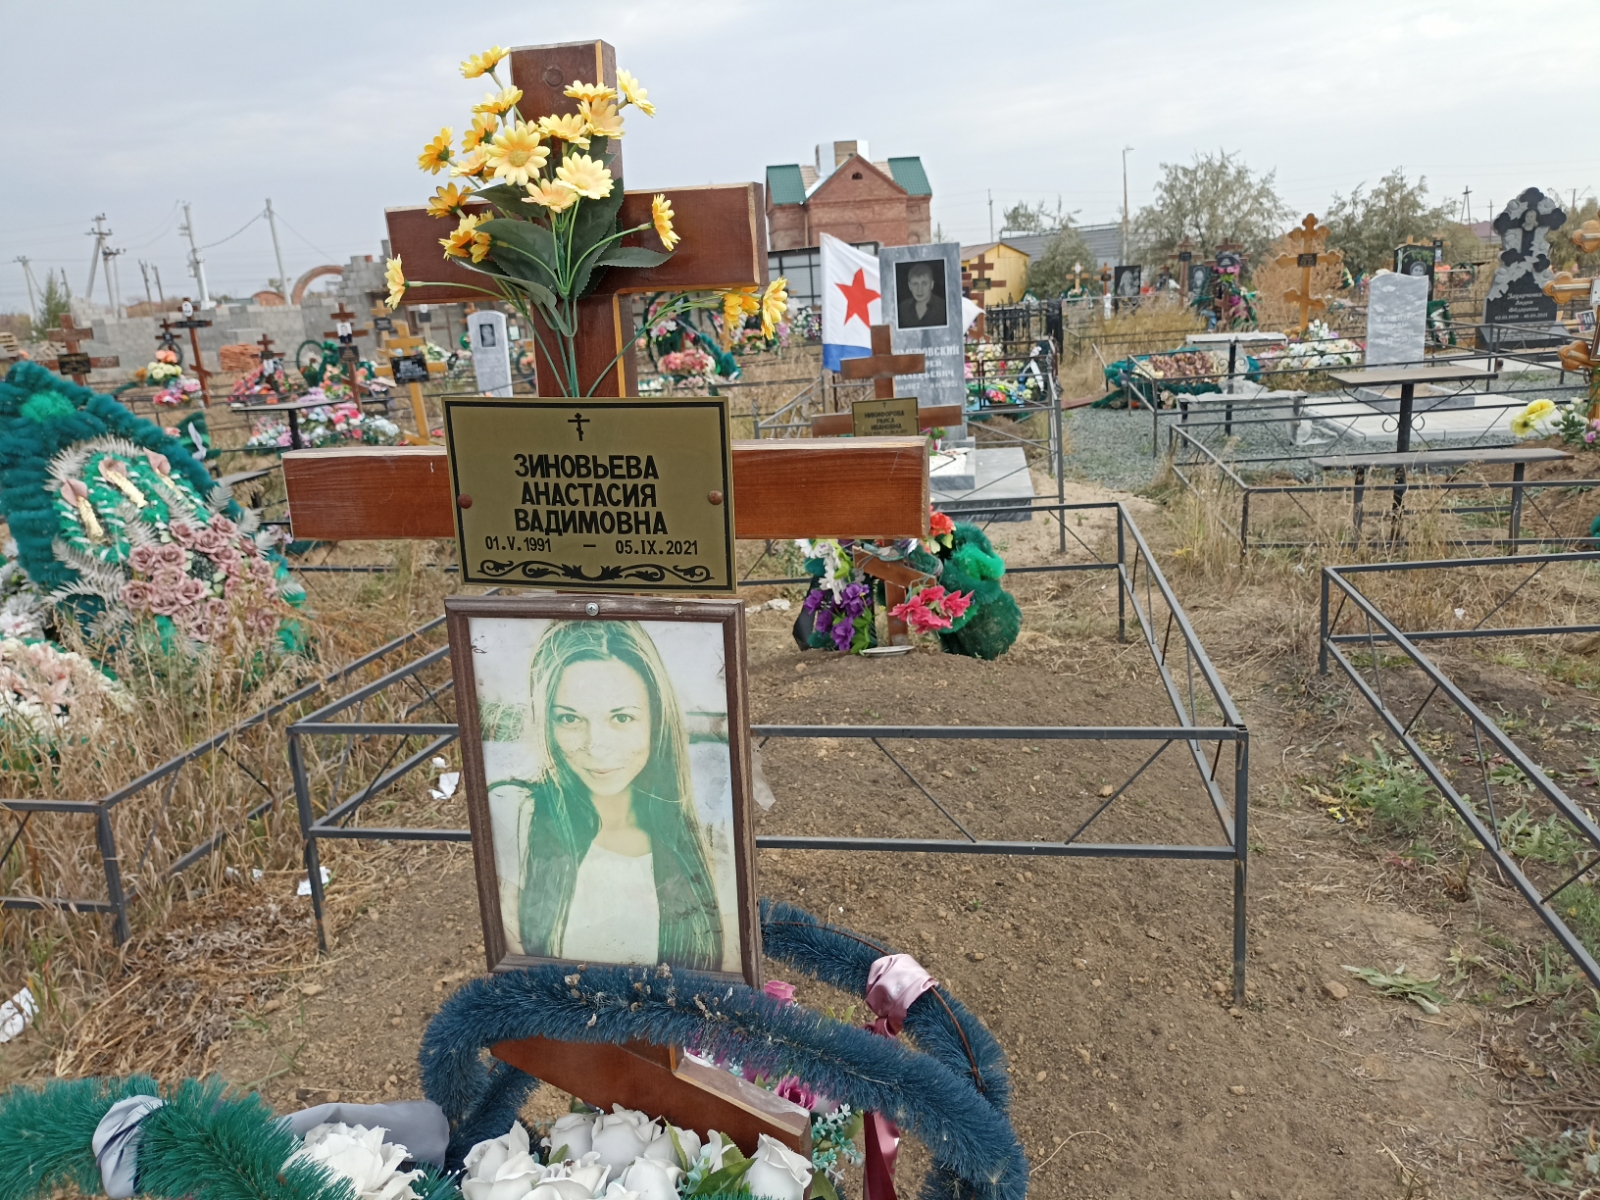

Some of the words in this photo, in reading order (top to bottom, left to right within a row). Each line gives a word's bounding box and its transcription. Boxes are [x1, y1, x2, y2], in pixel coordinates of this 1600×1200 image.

[513, 453, 660, 480] ЗИНОВЬЕВА
[521, 481, 657, 508] АНАСТАСИЯ
[514, 508, 669, 537] ВАДИМОВНА
[485, 535, 552, 553] 01.V.1991
[615, 539, 698, 555] 05.IX.2021
